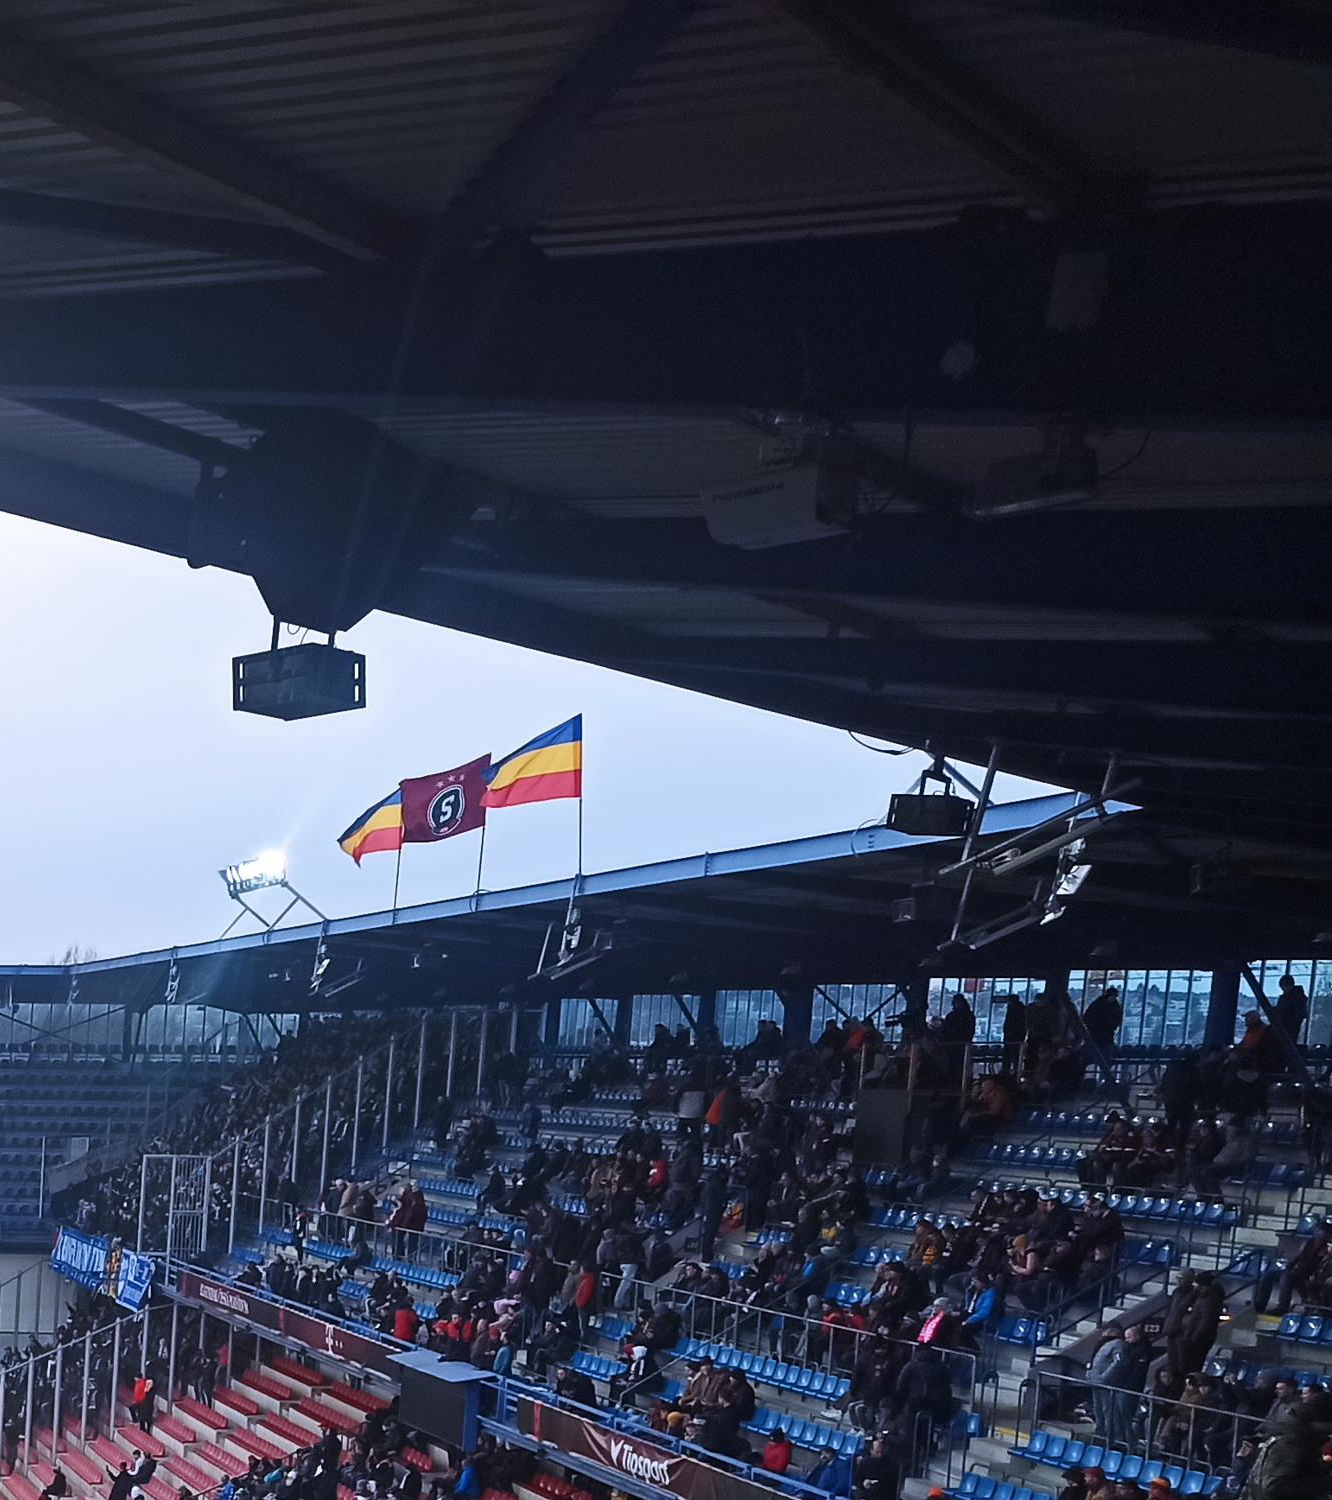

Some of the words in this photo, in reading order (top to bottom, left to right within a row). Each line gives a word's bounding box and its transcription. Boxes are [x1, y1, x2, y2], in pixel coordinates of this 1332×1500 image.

[439, 795, 455, 823] S
[1144, 1324, 1160, 1333] E23
[622, 1444, 671, 1486] Tipsport
